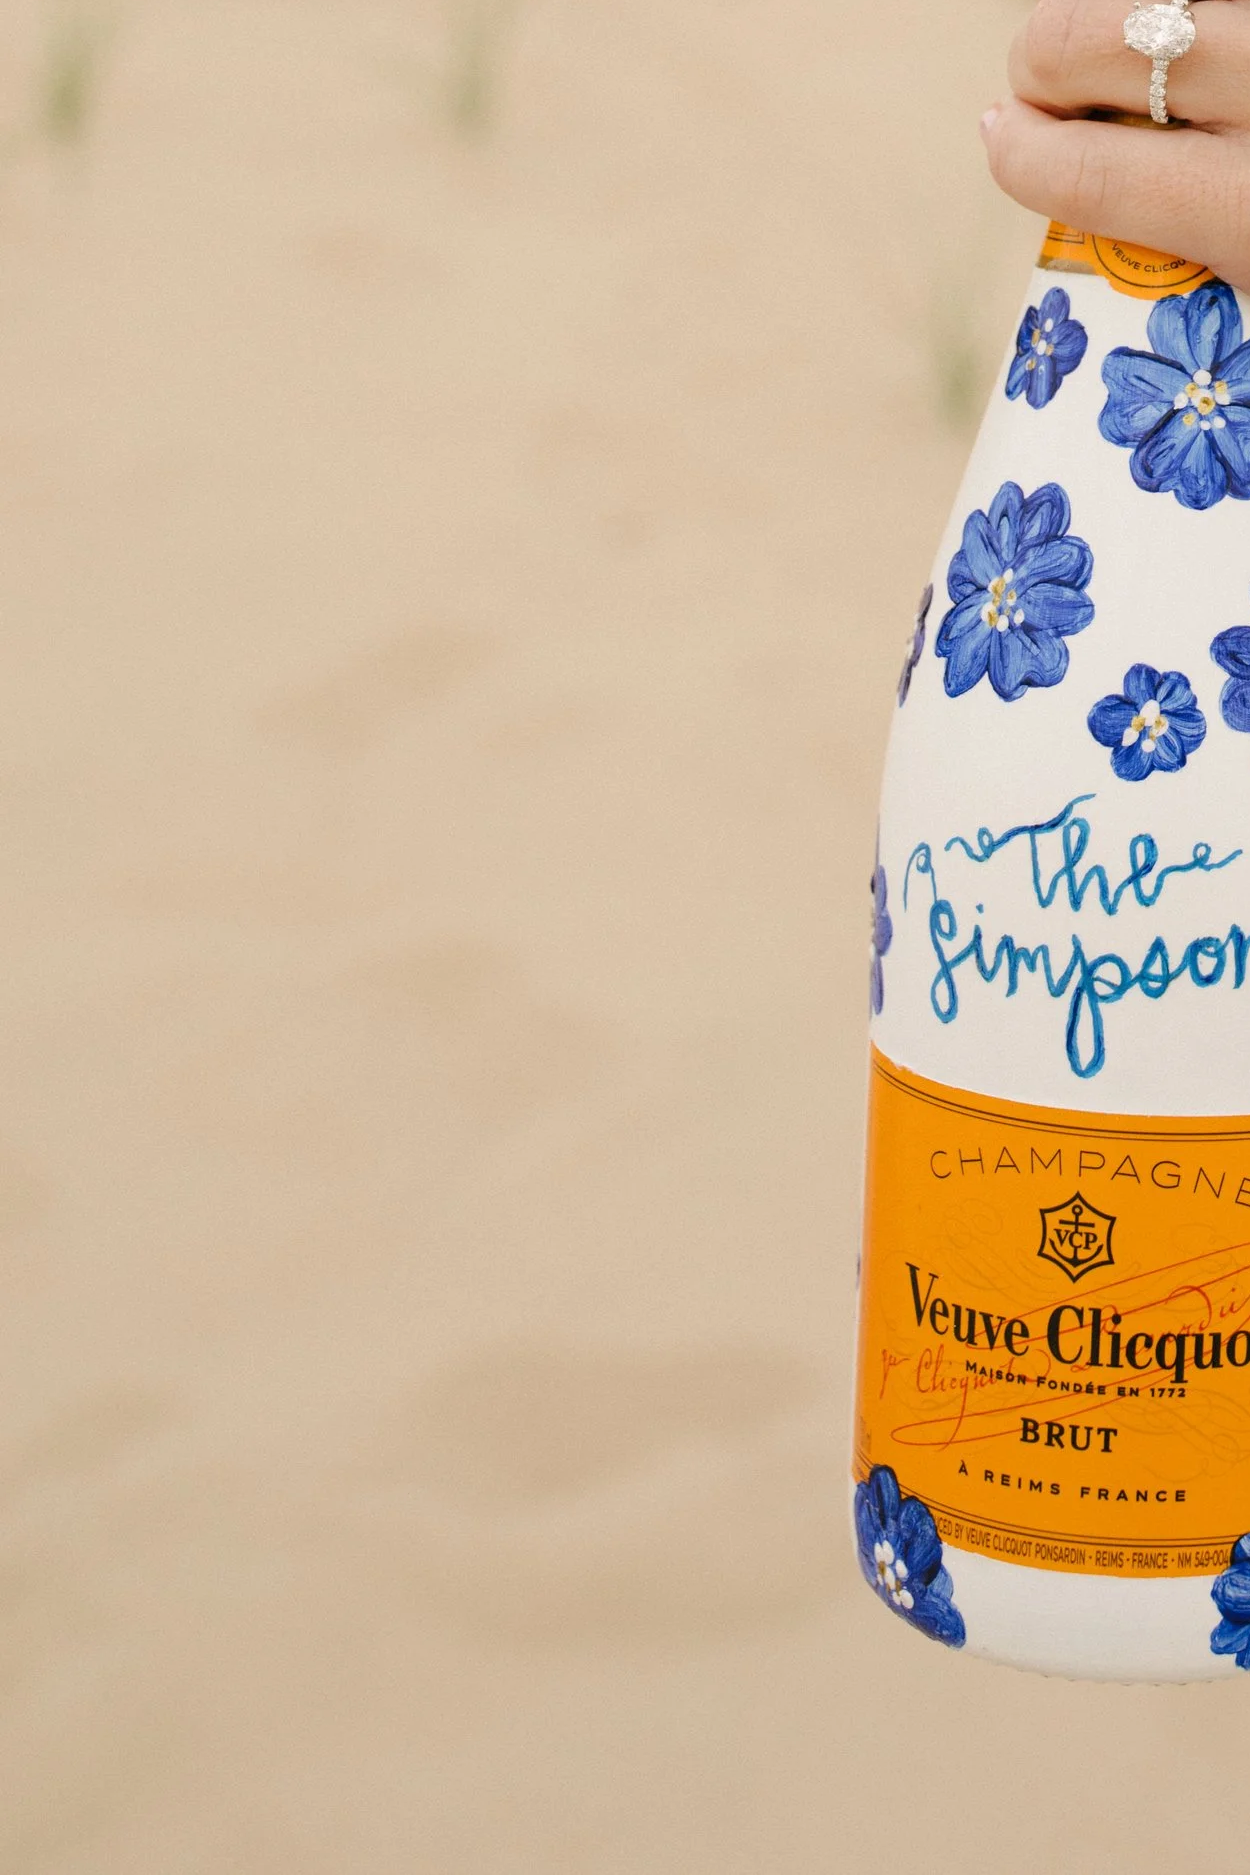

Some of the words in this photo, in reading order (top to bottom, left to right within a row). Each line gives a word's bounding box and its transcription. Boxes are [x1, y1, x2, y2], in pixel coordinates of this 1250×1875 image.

[1111, 243, 1141, 270] VEUVE
[1054, 1228, 1098, 1251] VCP
[905, 1262, 1030, 1356] Veuve
[966, 1360, 1027, 1385] MAISON
[1036, 1376, 1106, 1396] FONDÉE
[1117, 1386, 1139, 1397] EN
[1150, 1388, 1186, 1398] 1772
[1020, 1417, 1118, 1453] BRUT
[958, 1460, 969, 1476] À
[984, 1470, 1061, 1495] REIMS
[1080, 1486, 1187, 1503] FRANCE
[935, 1514, 952, 1536] CED
[955, 1523, 964, 1541] BY
[966, 1527, 990, 1549] VEUVE
[992, 1536, 1032, 1558] CLICQUOT
[1034, 1543, 1086, 1566] PONSARDIN
[1095, 1550, 1124, 1568] REIMS
[1131, 1552, 1168, 1569] FRANCE
[1177, 1552, 1192, 1568] NM
